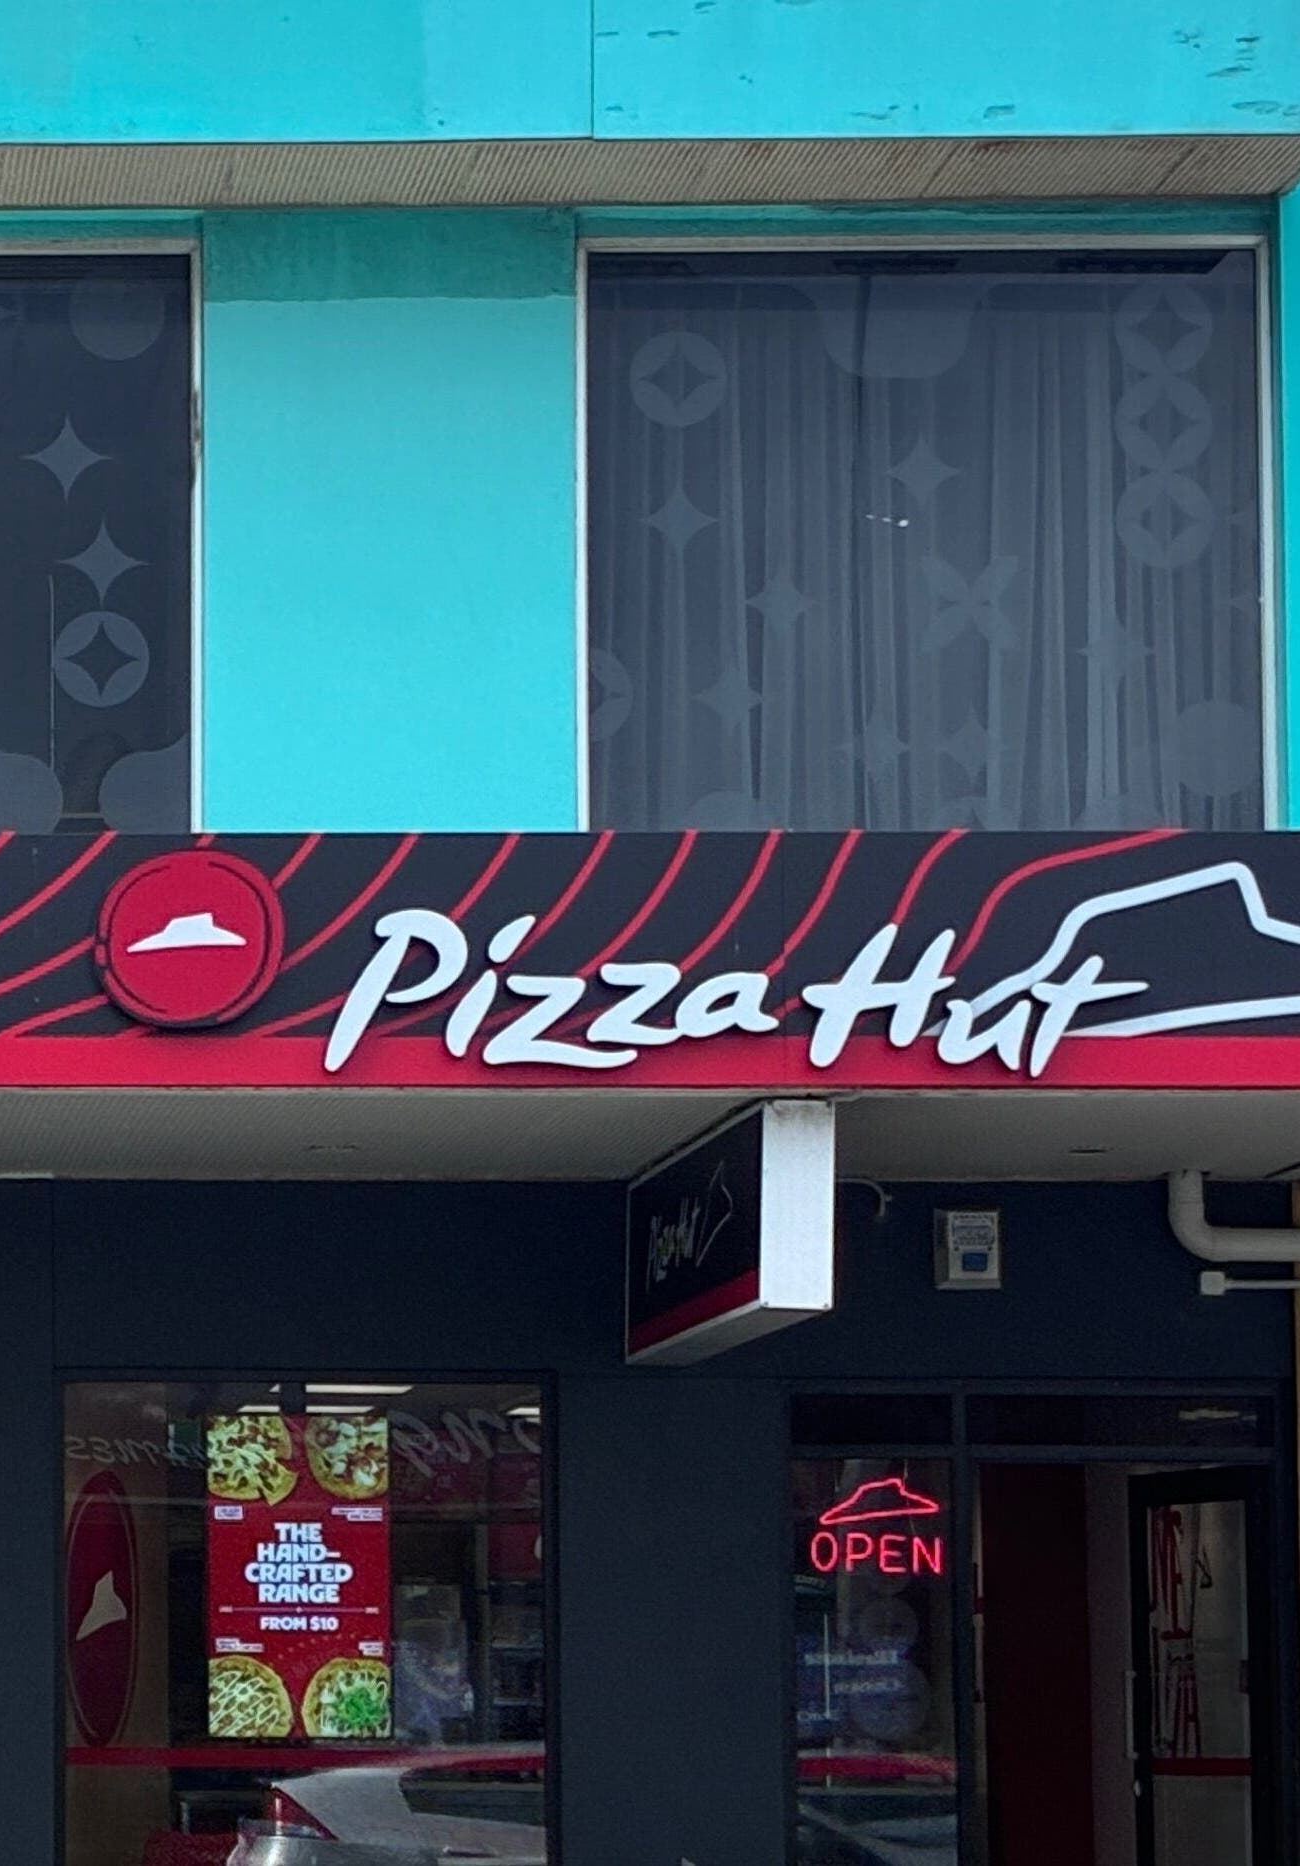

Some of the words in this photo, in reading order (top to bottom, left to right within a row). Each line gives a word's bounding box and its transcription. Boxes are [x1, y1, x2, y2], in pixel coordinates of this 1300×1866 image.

[323, 907, 779, 1074] Pizza
[803, 923, 1150, 1078] Hut
[274, 1522, 323, 1543] THE
[256, 1543, 341, 1563] HAND-
[810, 1532, 943, 1575] OPEN
[244, 1563, 354, 1583] CRAFTED
[258, 1584, 341, 1604] RANGE
[260, 1616, 308, 1631] FROM
[309, 1616, 339, 1631] $10
